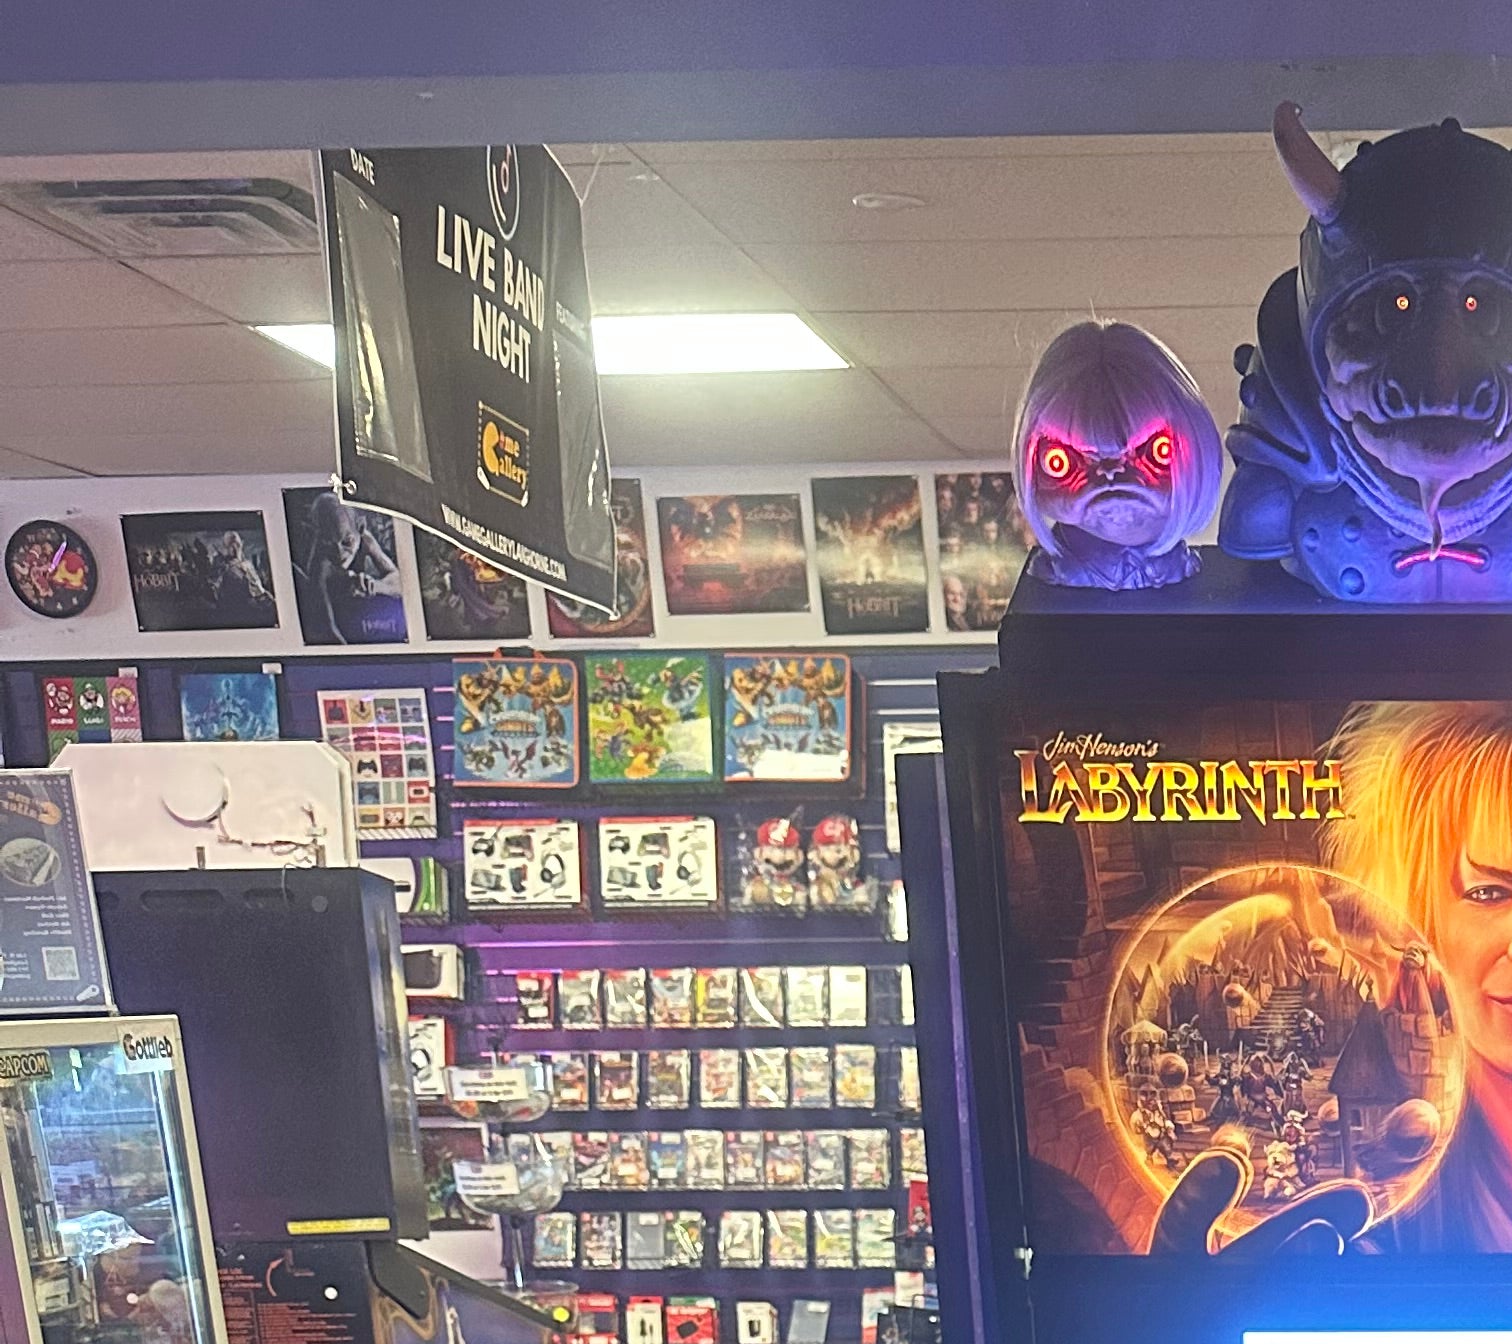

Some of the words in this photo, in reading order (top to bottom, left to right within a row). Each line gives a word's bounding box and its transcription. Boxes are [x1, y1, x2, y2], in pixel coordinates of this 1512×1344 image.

[350, 147, 375, 186] DATE
[437, 204, 496, 292] LIVE
[503, 246, 545, 332] BAND
[473, 294, 531, 384] NIGHT
[1043, 731, 1082, 761] Jim
[1014, 750, 1346, 825] LABYRINTH
